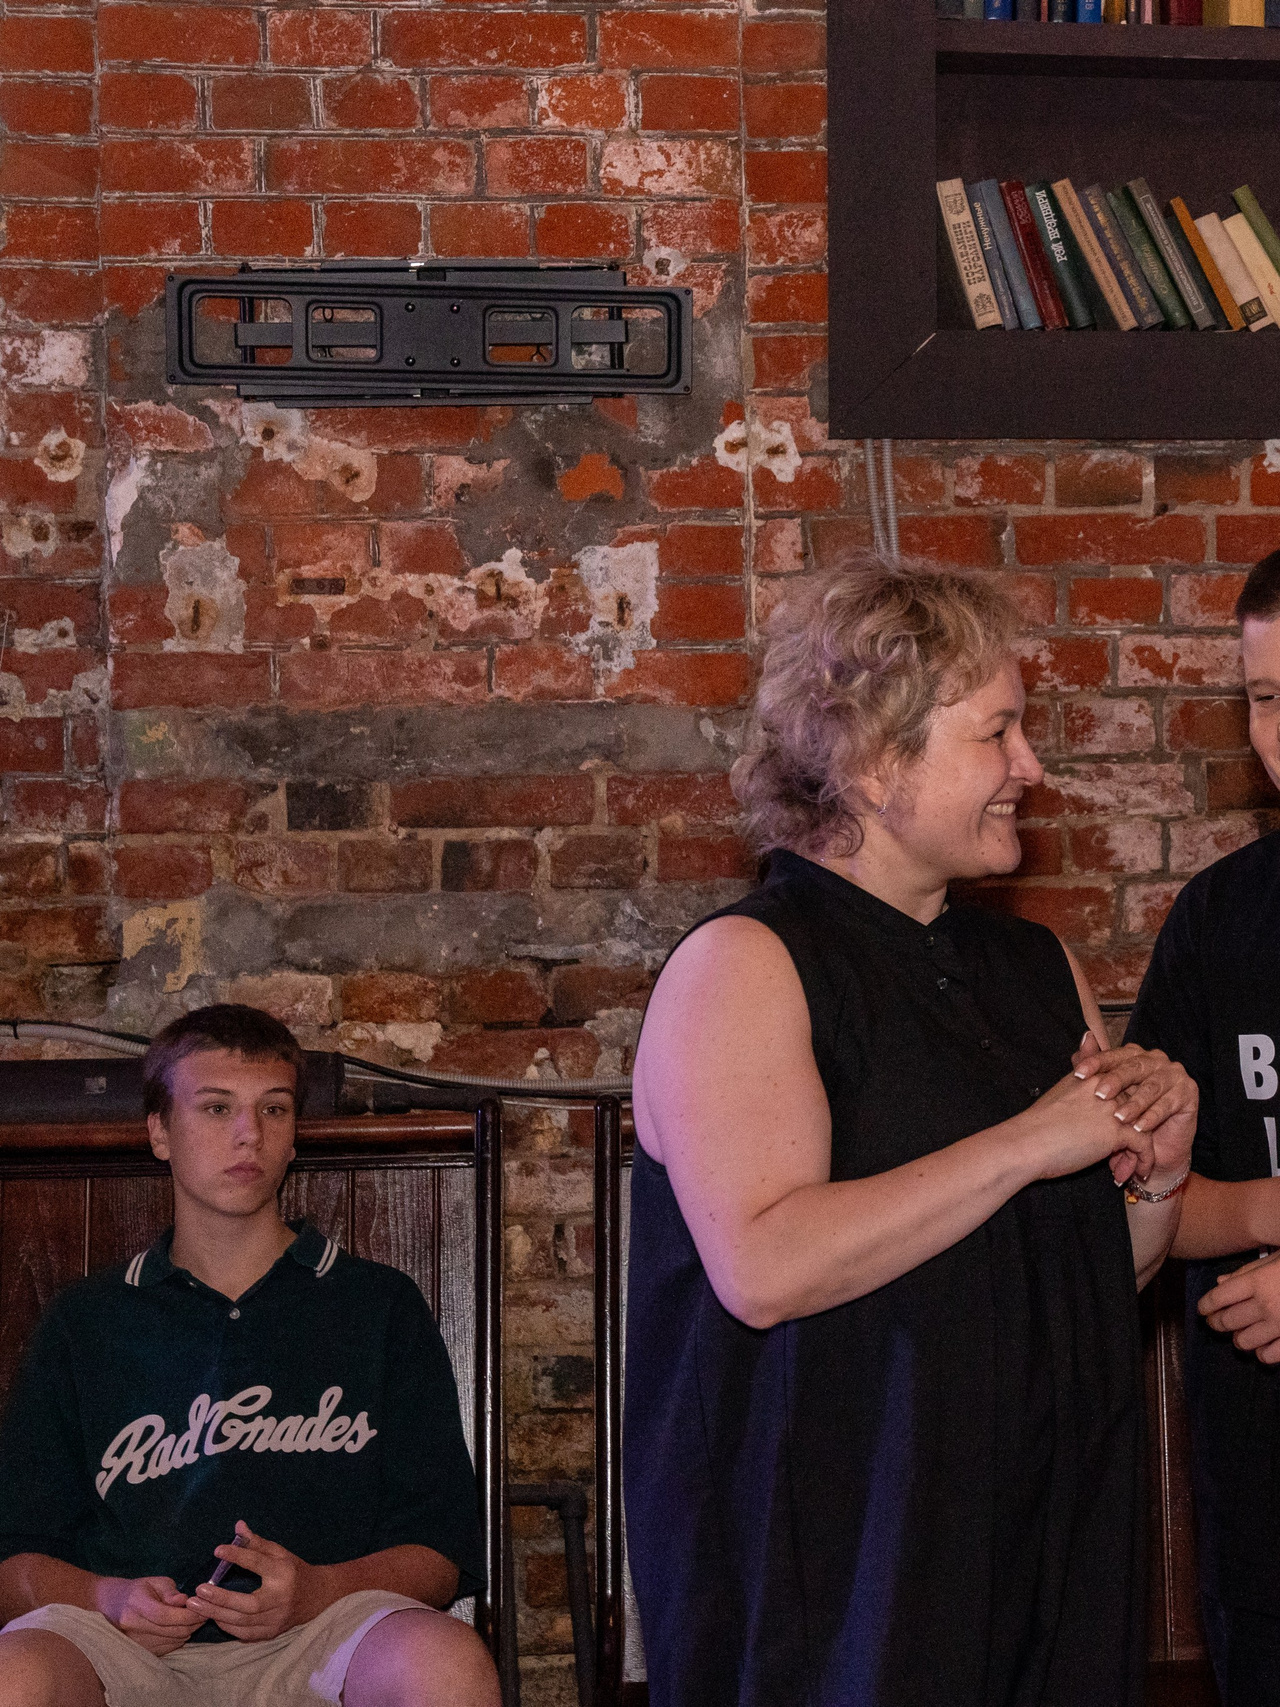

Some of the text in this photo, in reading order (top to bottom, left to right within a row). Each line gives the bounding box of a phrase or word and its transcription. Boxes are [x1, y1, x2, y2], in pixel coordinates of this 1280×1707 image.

[973, 202, 992, 250] Ненужные
[1035, 190, 1061, 241] БРЭДБЕРИ
[952, 222, 977, 286] ПОСЛЕДНИЕ
[962, 220, 986, 283] КАРОЛИНГИ
[1051, 241, 1068, 263] РЭЙ
